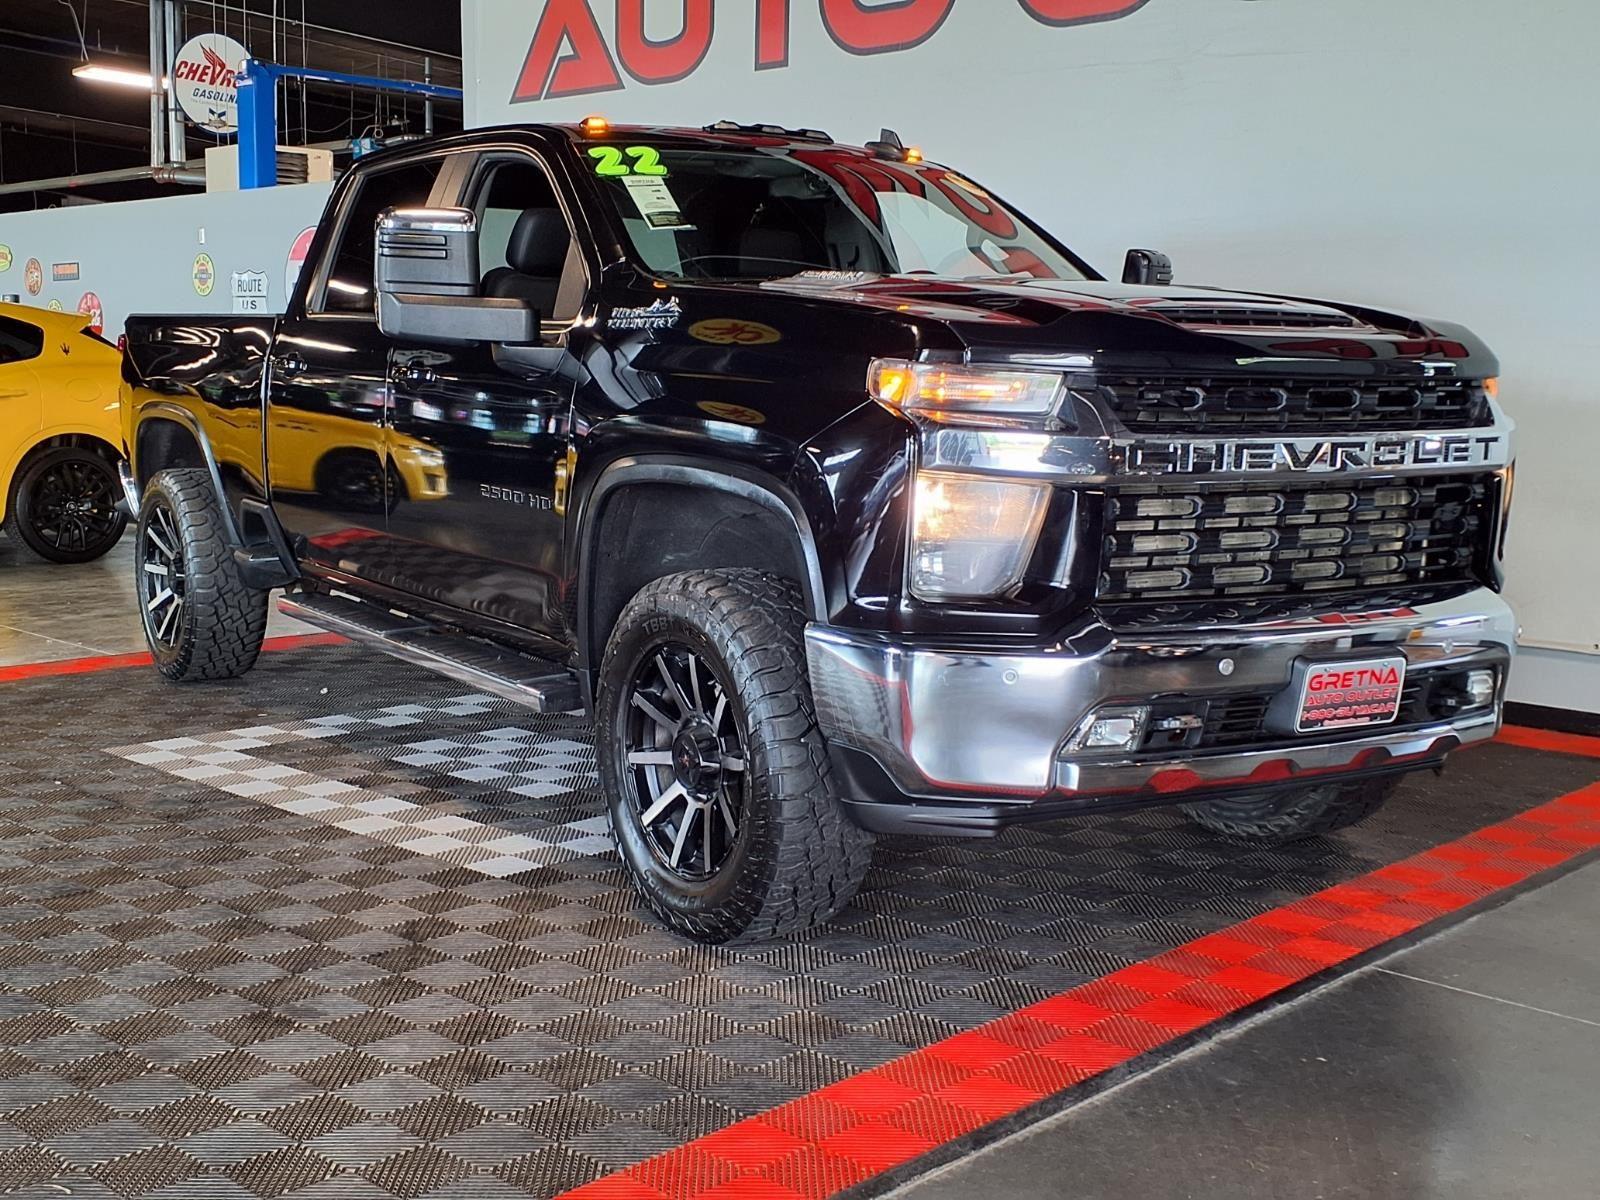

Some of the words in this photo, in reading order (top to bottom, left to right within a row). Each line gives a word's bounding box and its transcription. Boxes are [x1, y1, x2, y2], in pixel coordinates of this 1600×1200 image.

[192, 87, 238, 104] GASOLIN
[588, 146, 668, 176] 22
[237, 279, 262, 292] ROUTE
[241, 300, 257, 310] US
[1125, 436, 1500, 472] CHEVROLET
[480, 483, 524, 504] 2500
[528, 493, 552, 510] HD
[1308, 667, 1399, 692] GRETNA
[1304, 691, 1343, 706] AUTO
[1345, 687, 1399, 702] OUTLET
